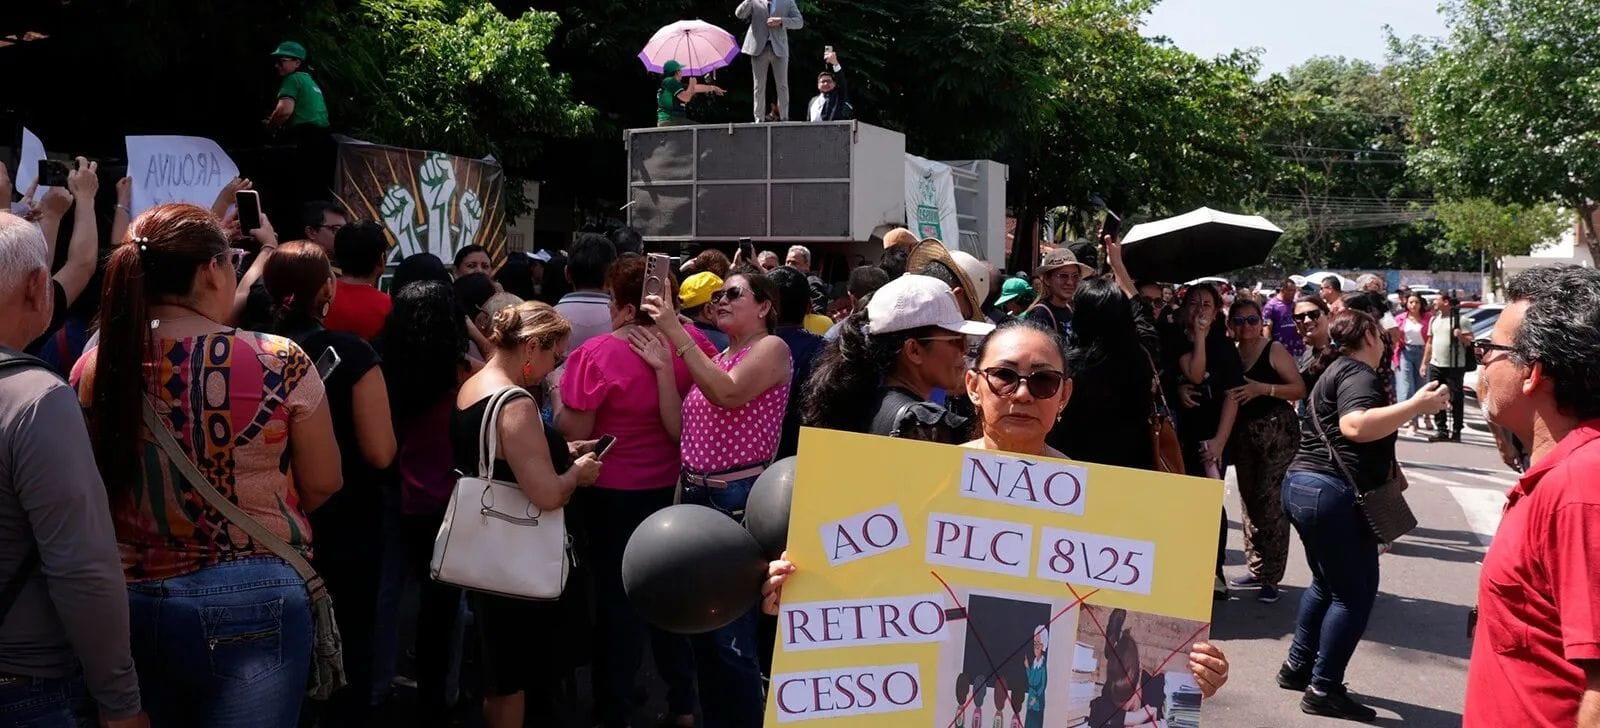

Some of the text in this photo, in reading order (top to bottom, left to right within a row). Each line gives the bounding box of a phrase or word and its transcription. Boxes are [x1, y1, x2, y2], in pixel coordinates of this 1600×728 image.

[967, 457, 1081, 507] NÃO
[831, 513, 1143, 586] AO PLC 8\25
[784, 600, 945, 644] RETRO
[776, 671, 918, 714] CESSO
